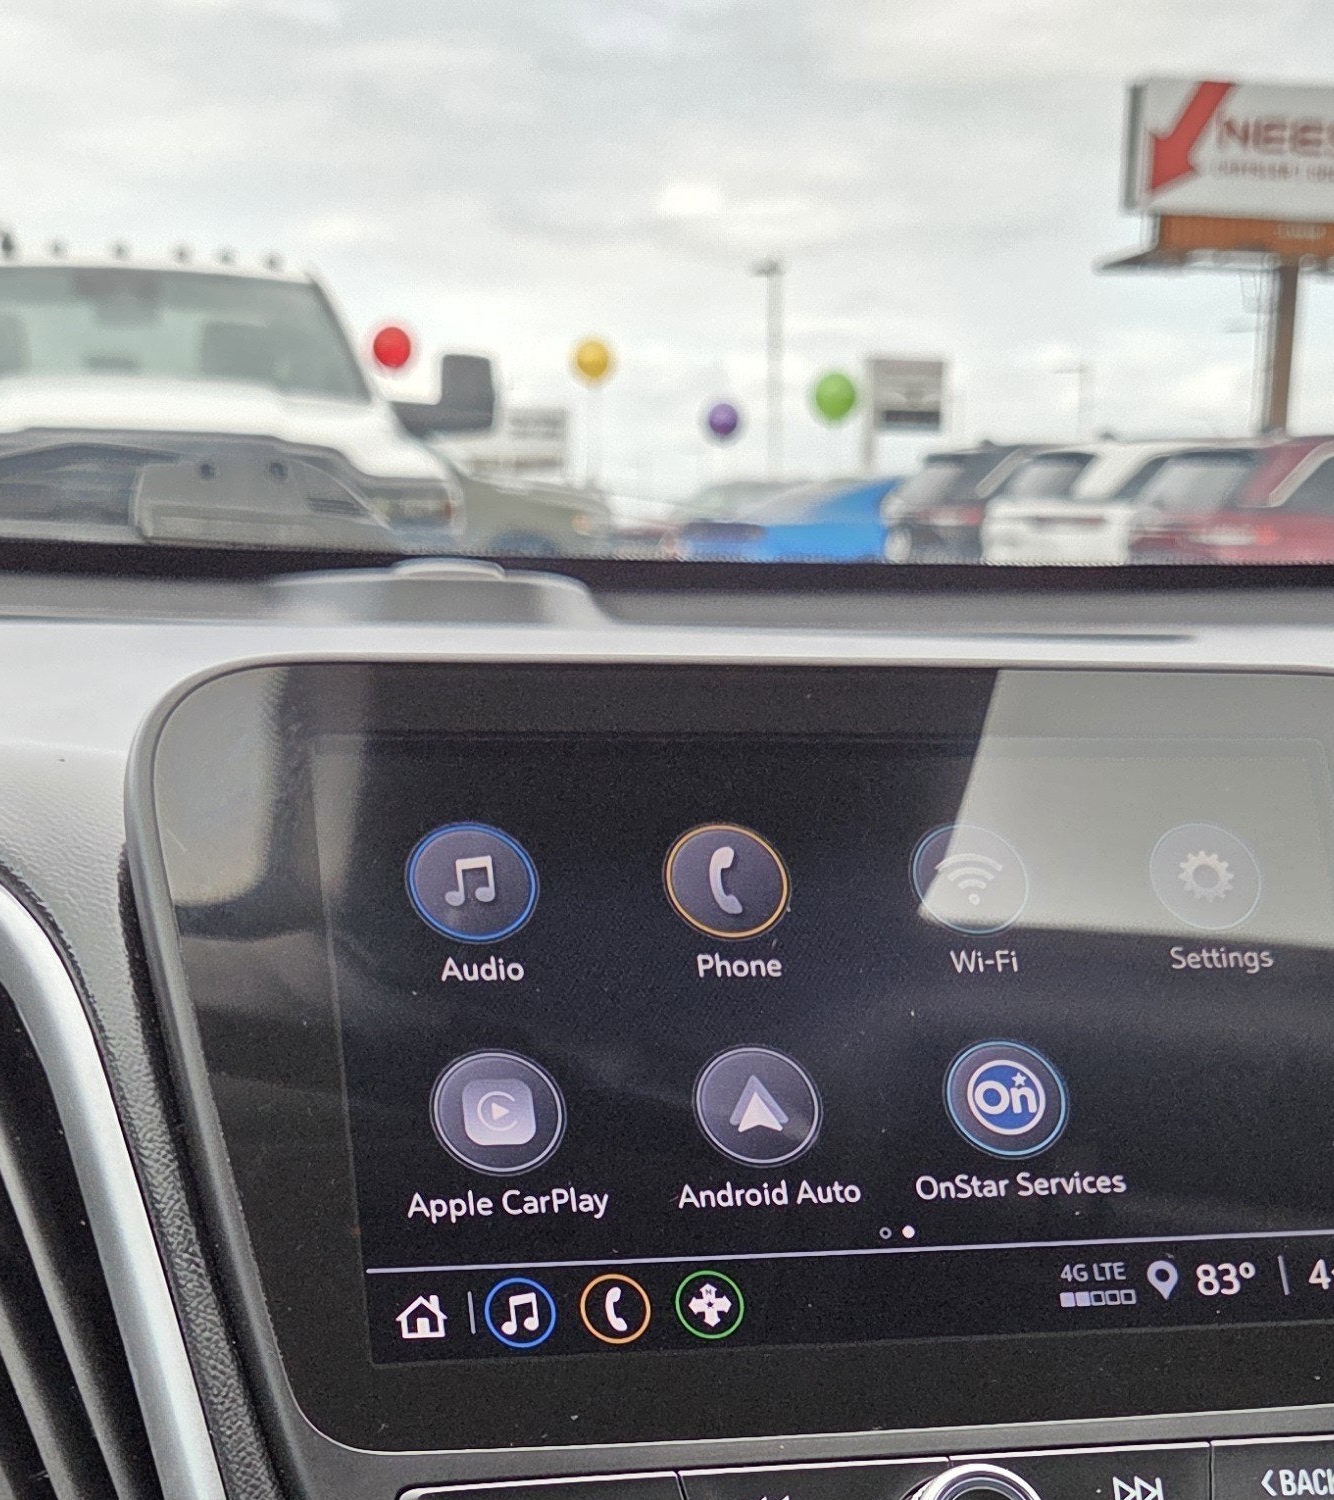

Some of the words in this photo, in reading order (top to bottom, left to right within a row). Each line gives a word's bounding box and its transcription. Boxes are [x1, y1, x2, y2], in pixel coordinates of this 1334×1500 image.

[441, 956, 525, 983] Audio
[697, 953, 782, 979] Phone
[950, 950, 1018, 973] Wi-Fi
[1170, 947, 1274, 974] Settings
[974, 1080, 1038, 1115] On
[678, 1182, 788, 1208] Android
[796, 1180, 861, 1204] Auto
[915, 1174, 1009, 1200] OnStar
[1016, 1171, 1126, 1196] Services
[407, 1191, 495, 1224] Apple
[502, 1188, 609, 1219] CarPlay
[1061, 1263, 1088, 1282] 4G
[1093, 1262, 1127, 1281] LTE
